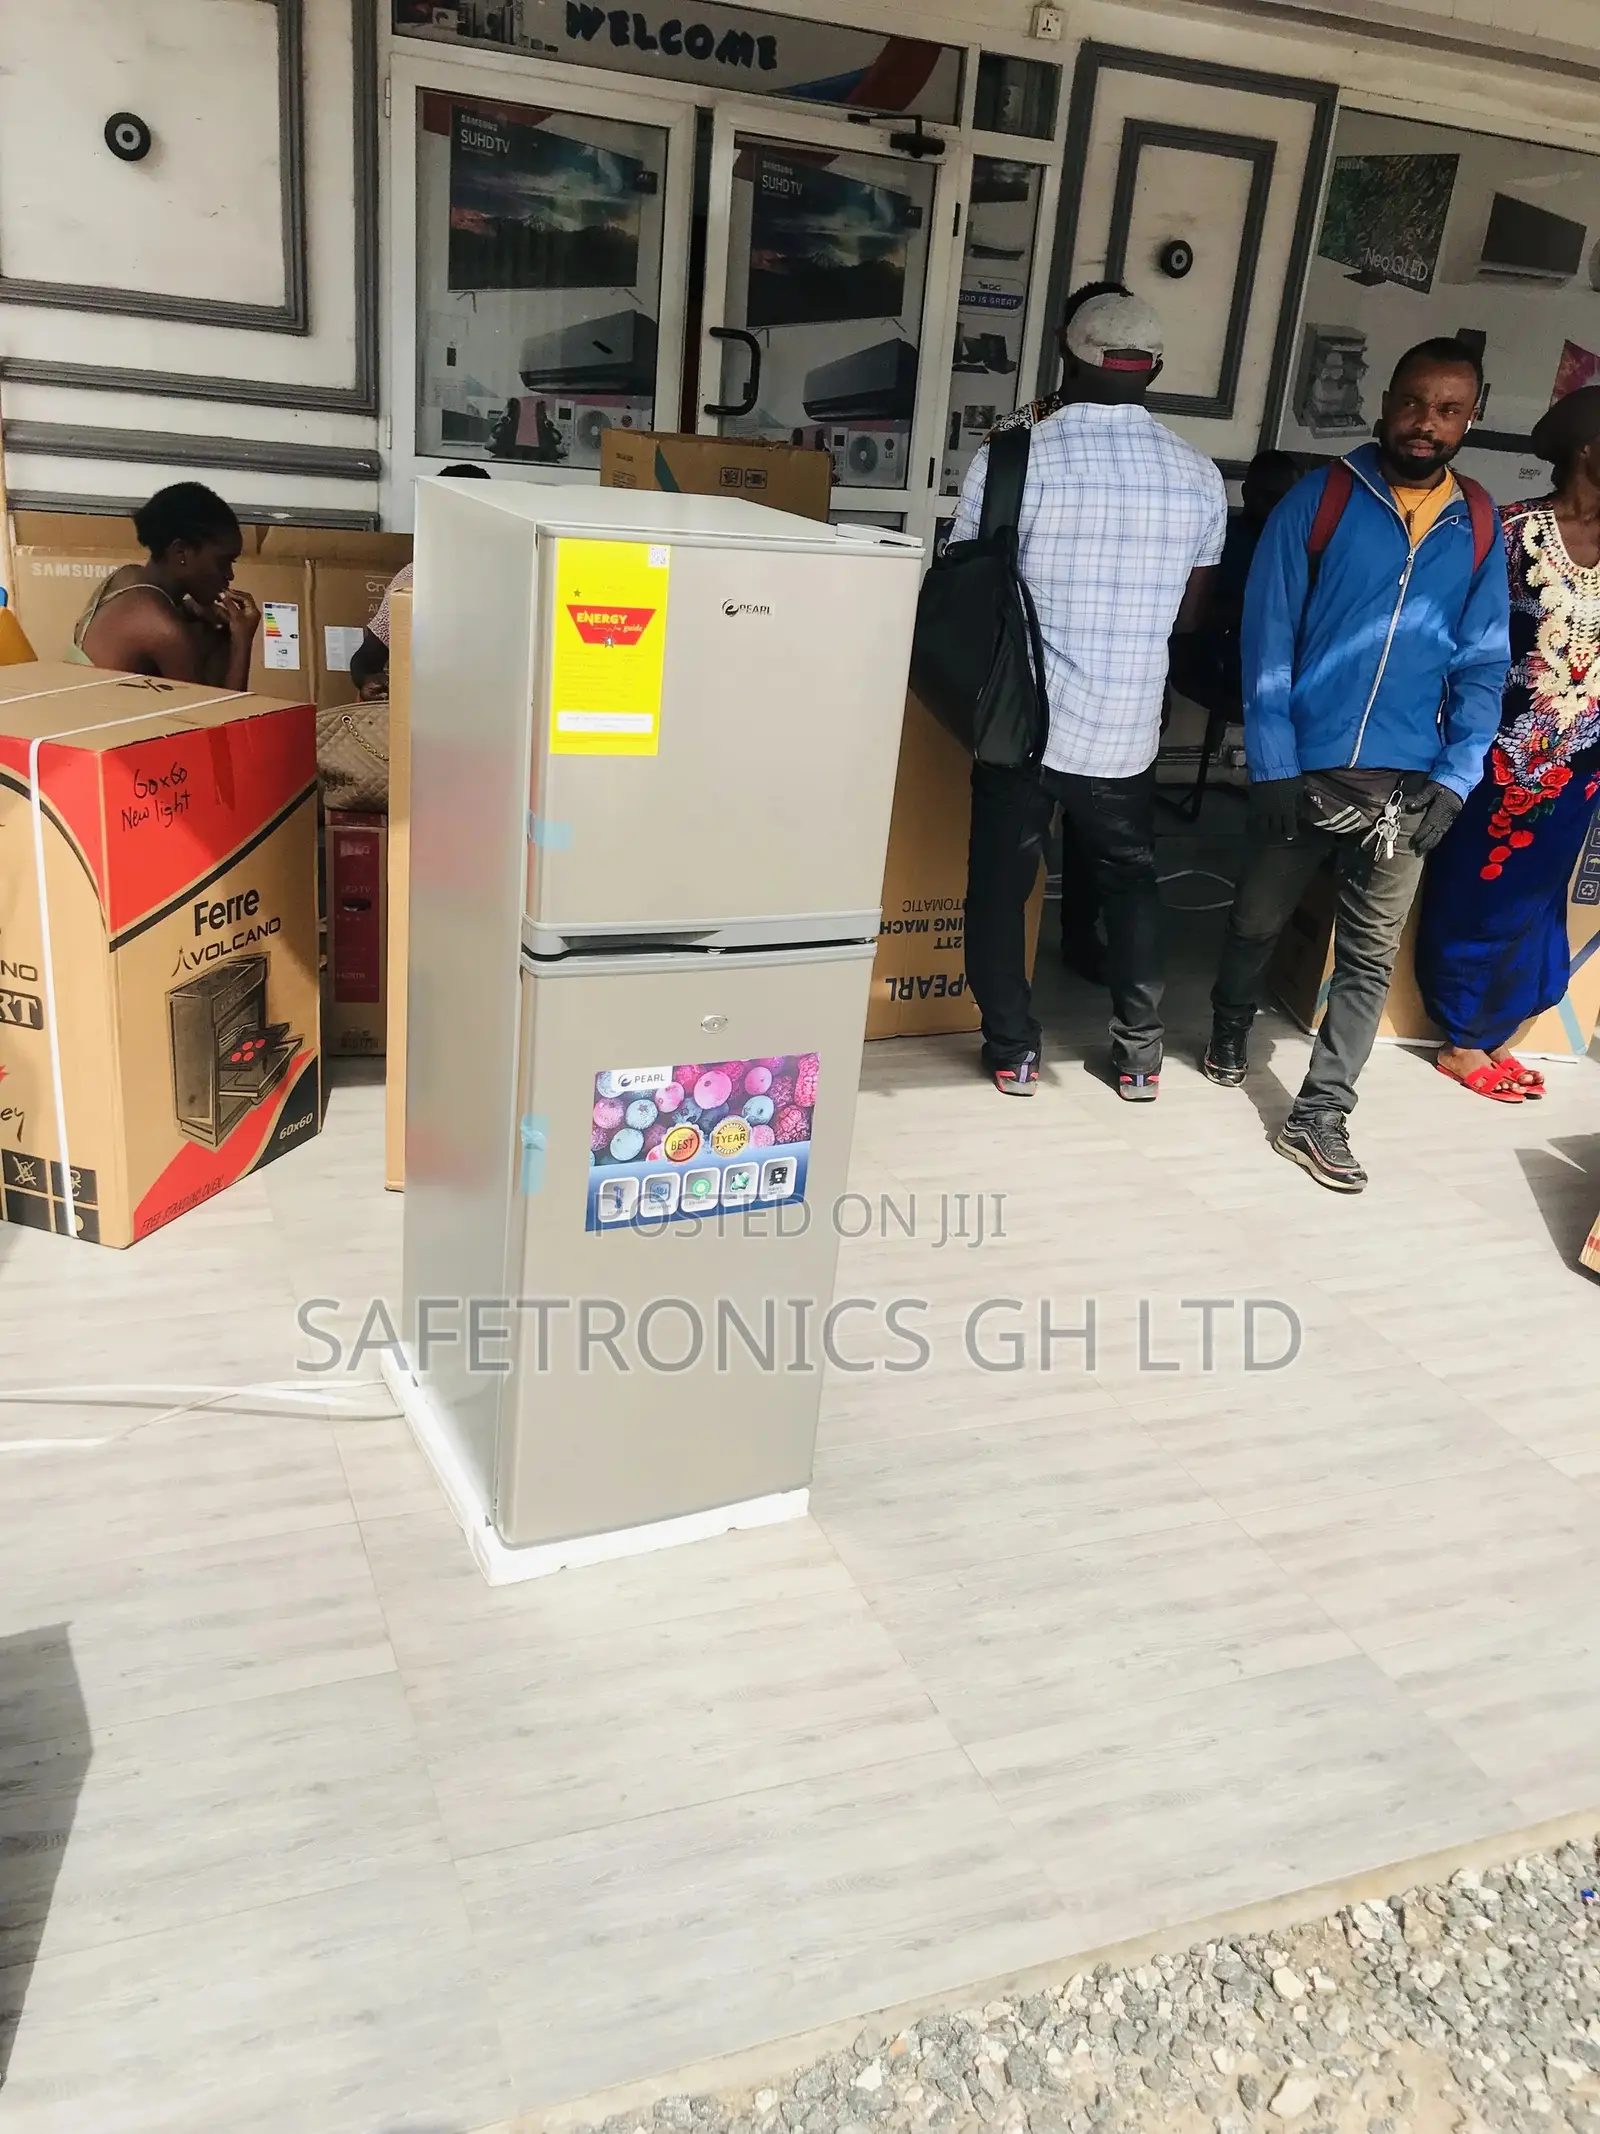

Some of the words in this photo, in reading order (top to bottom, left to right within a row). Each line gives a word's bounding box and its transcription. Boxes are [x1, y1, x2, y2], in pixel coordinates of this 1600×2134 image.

[566, 1, 778, 71] WELCOME
[1391, 255, 1429, 282] QLED
[577, 610, 629, 627] ENERGY
[622, 623, 644, 634] guide
[194, 888, 260, 937] Ferre
[190, 916, 281, 966] VOLCANO
[885, 973, 965, 1002] PEARL
[634, 1073, 666, 1084] PEARL
[278, 1111, 314, 1141] 60x60
[721, 1132, 747, 1144] YEAR
[671, 1137, 694, 1151] BEST
